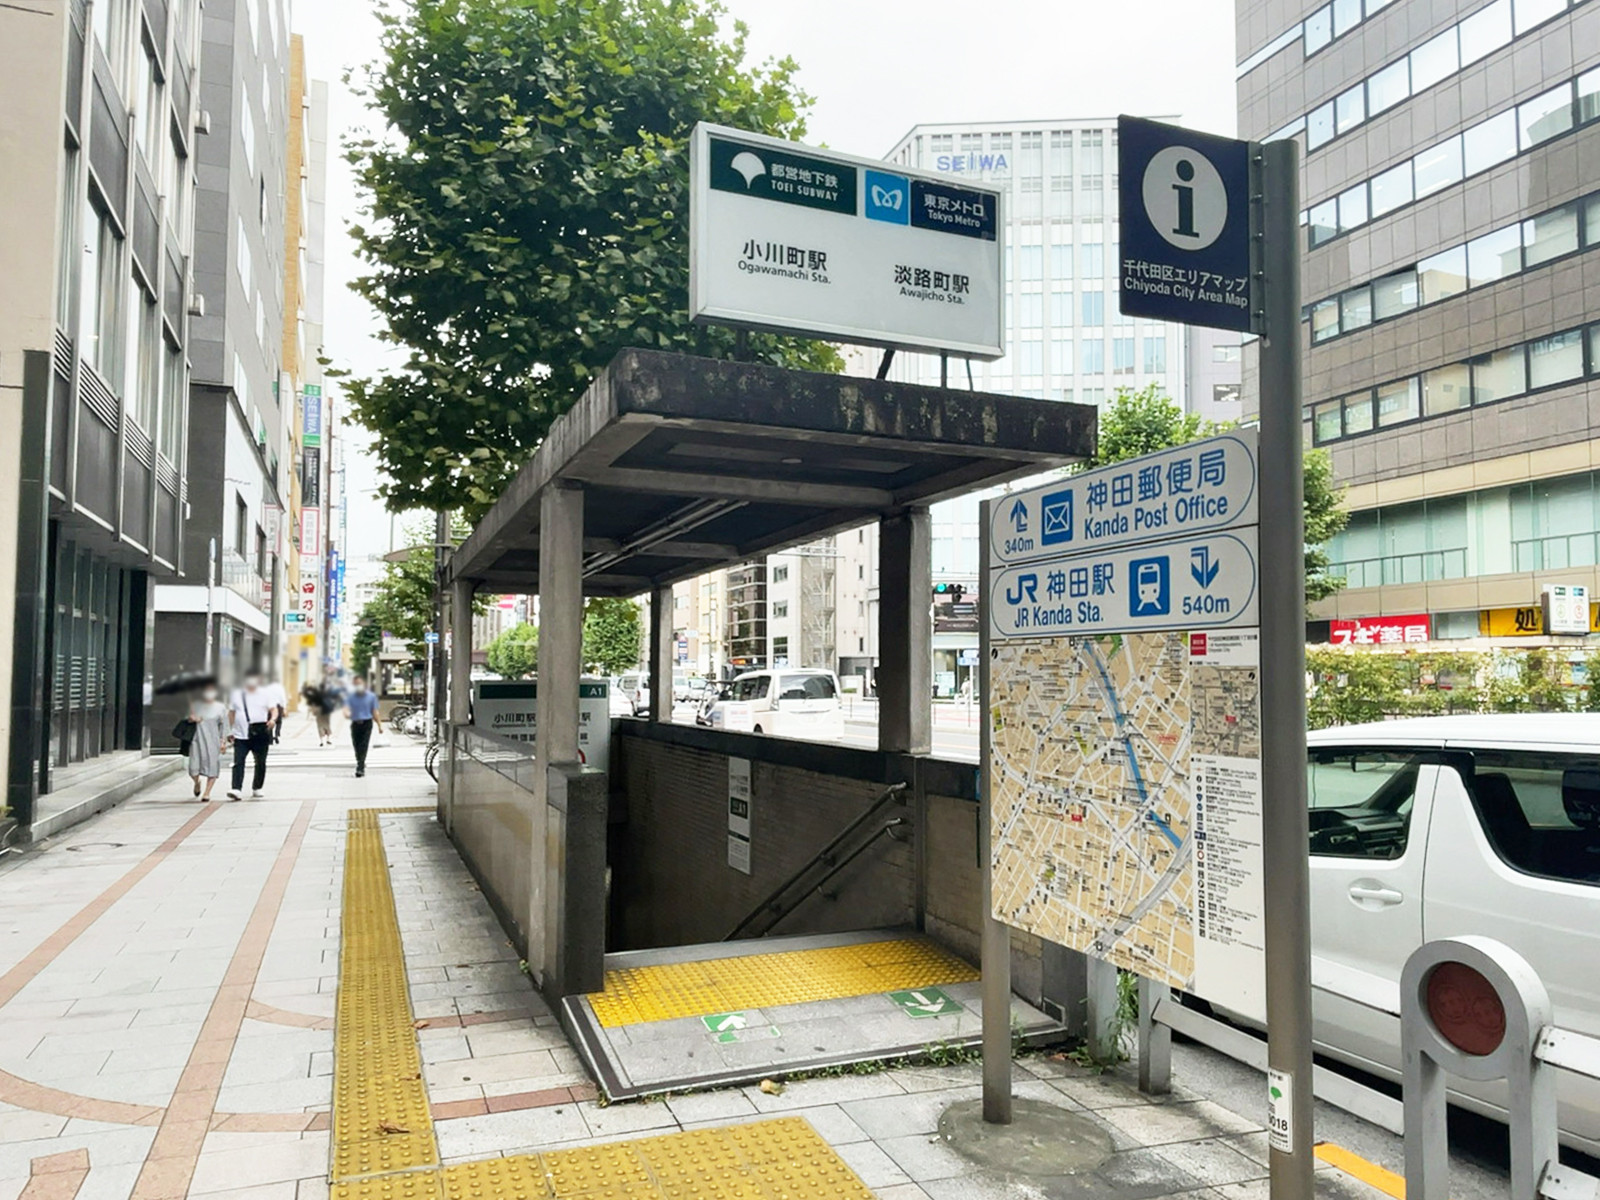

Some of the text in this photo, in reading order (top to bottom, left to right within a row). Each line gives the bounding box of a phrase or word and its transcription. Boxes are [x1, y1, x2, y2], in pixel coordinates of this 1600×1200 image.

[937, 152, 1008, 172] SEIWA
[771, 163, 838, 189] 都営地下鉄
[771, 180, 838, 202] TOEI SUBWAY
[924, 193, 984, 217] 東京メトロ
[927, 209, 981, 228] Tokyo Metro
[743, 239, 827, 272] 小川町駅
[738, 260, 831, 284] Ogawamachi Sta.
[894, 265, 970, 294] 淡路町駅
[1123, 259, 1248, 292] 千代田区エリアマップ
[900, 287, 965, 305] Awajicho Sta.
[1124, 278, 1248, 309] Chiyoda City Area Map
[1086, 449, 1226, 514] 神田郵便局
[1084, 495, 1228, 540] Kanda Post Office
[1004, 537, 1034, 556] 340m
[1006, 562, 1115, 605] JR 神田駅
[1014, 601, 1104, 628] JR Kanda Sta.
[1183, 595, 1230, 615] 540m
[1514, 608, 1542, 632] 処
[1334, 624, 1428, 645] スギ薬局
[589, 687, 602, 696] A1
[494, 712, 537, 723] 小川町駅
